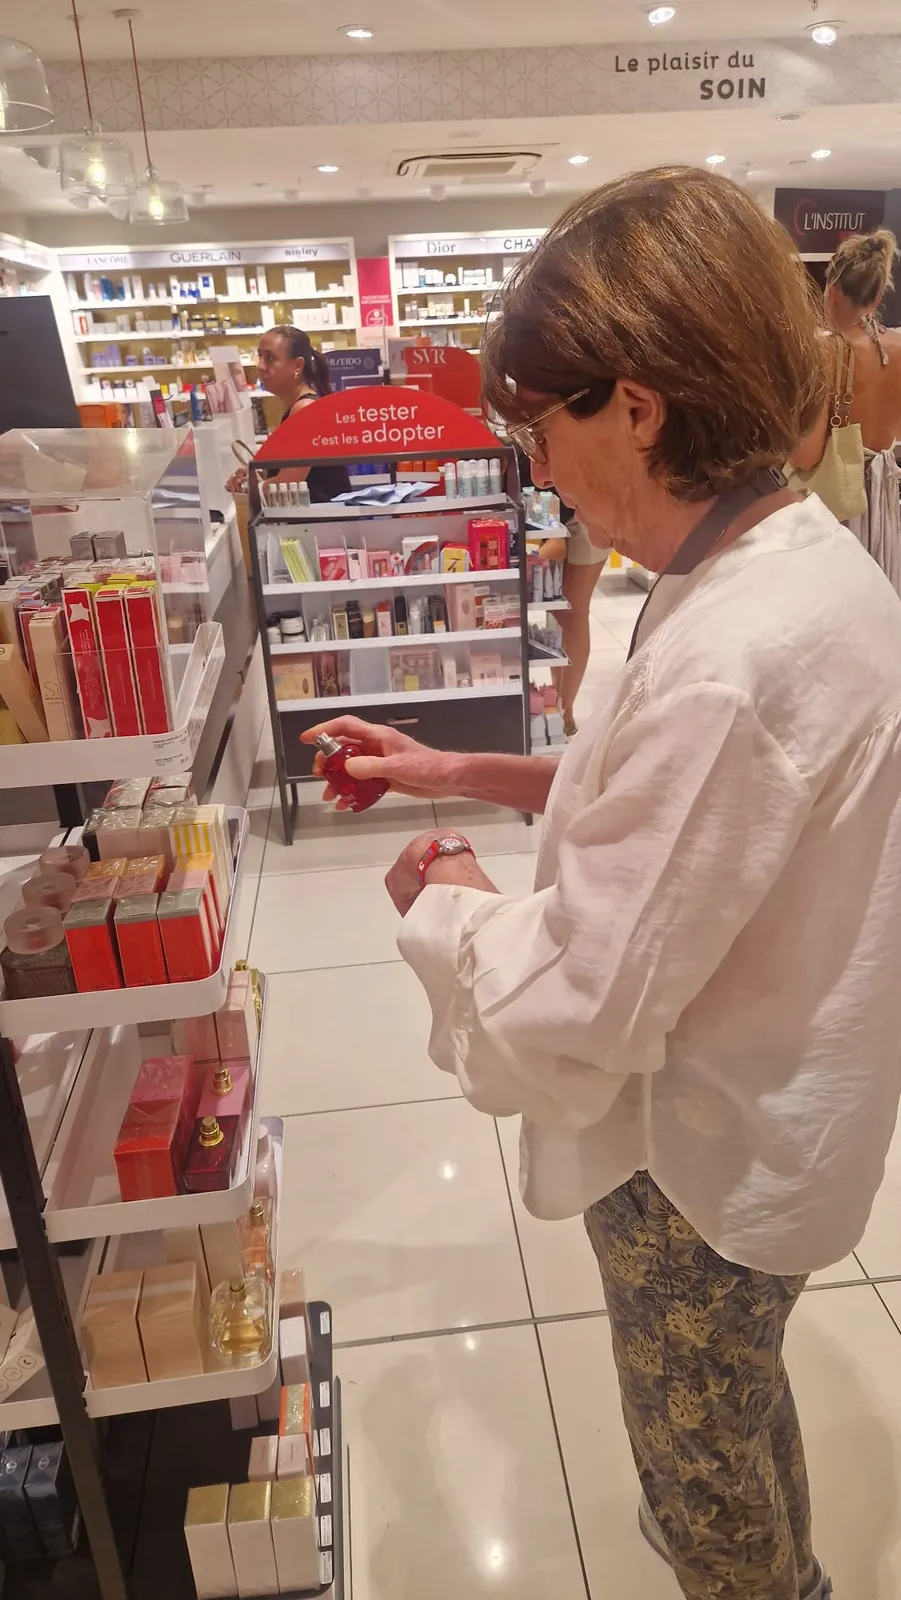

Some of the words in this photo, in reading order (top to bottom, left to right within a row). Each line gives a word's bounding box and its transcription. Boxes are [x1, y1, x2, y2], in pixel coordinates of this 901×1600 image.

[615, 55, 639, 73] Le
[647, 50, 719, 76] plaisir
[728, 50, 755, 69] du
[700, 78, 766, 100] SOIN
[804, 212, 867, 231] L'INSTITUT
[284, 246, 319, 258] sisley
[426, 240, 457, 255] Dior
[503, 237, 542, 251] CHAN
[169, 250, 242, 265] GUERLAIN
[326, 356, 362, 367] HISEIDO
[412, 348, 448, 366] SVR
[335, 412, 357, 424] Les
[357, 403, 419, 423] tester
[311, 433, 339, 446] c'est
[342, 432, 359, 445] les
[361, 421, 445, 447] adopter
